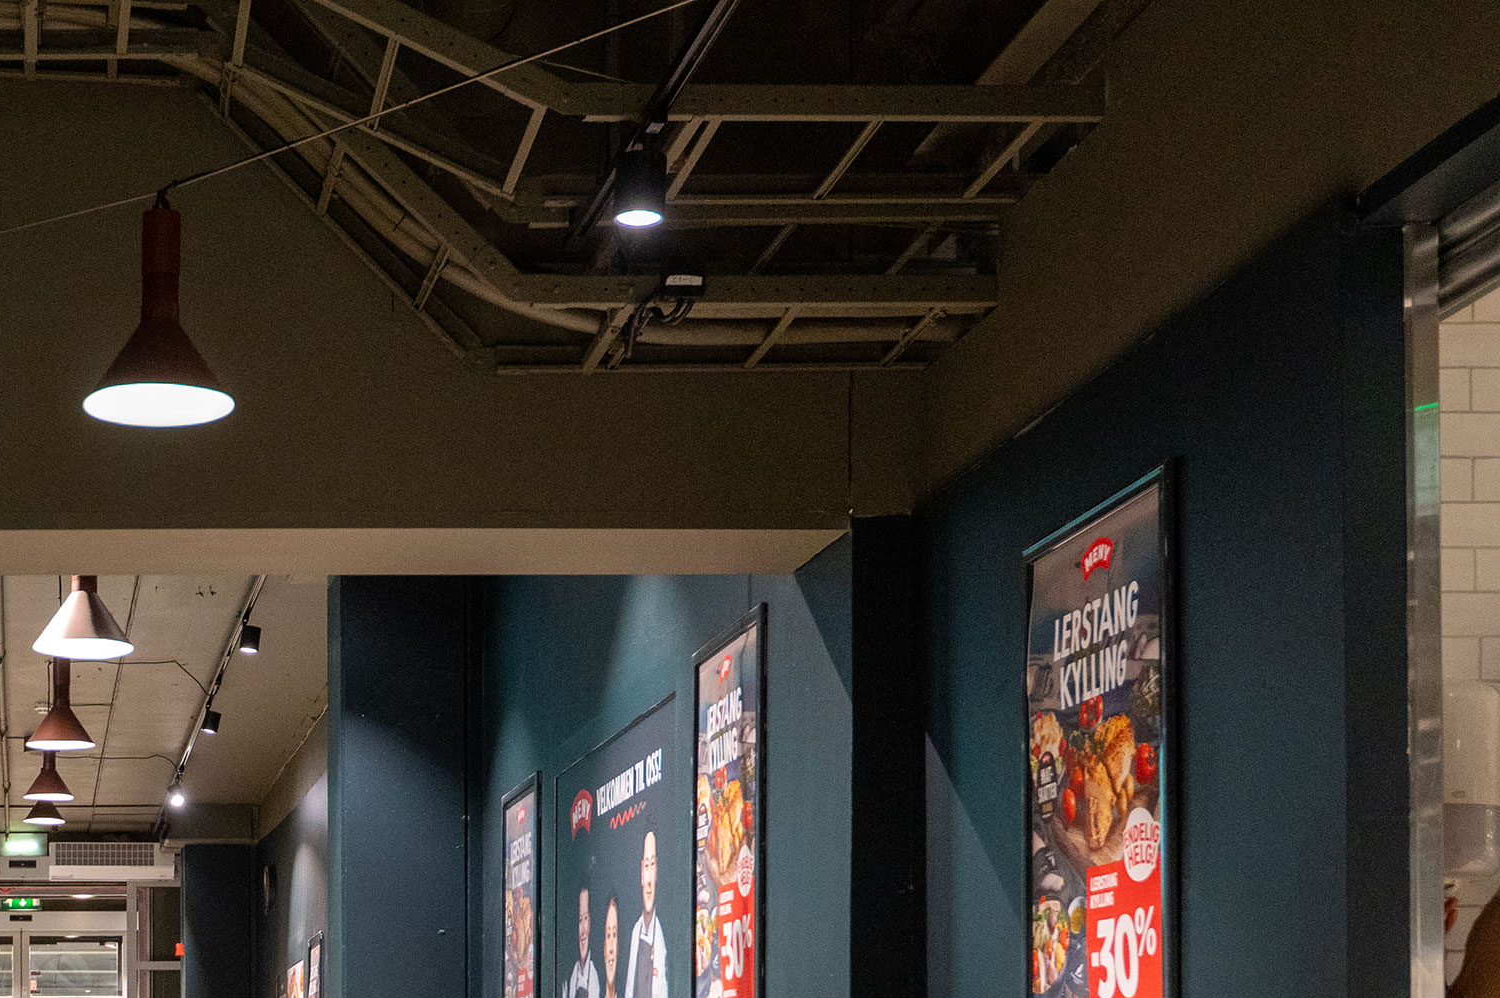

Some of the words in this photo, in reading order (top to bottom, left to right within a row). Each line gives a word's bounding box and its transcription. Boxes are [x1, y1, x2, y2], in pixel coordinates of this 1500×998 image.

[1084, 543, 1111, 572] MENY
[1053, 580, 1139, 662] LERSTANG
[1059, 639, 1128, 711] KYLLING
[707, 687, 743, 740] LERSTANG
[572, 798, 591, 829] MENY
[596, 766, 634, 816] VELKOMMEN
[634, 759, 645, 794] TIL
[646, 748, 662, 788] OSS!
[1123, 822, 1160, 849] ENDELIG
[1128, 843, 1157, 870] HELG!
[720, 914, 752, 981] -30%
